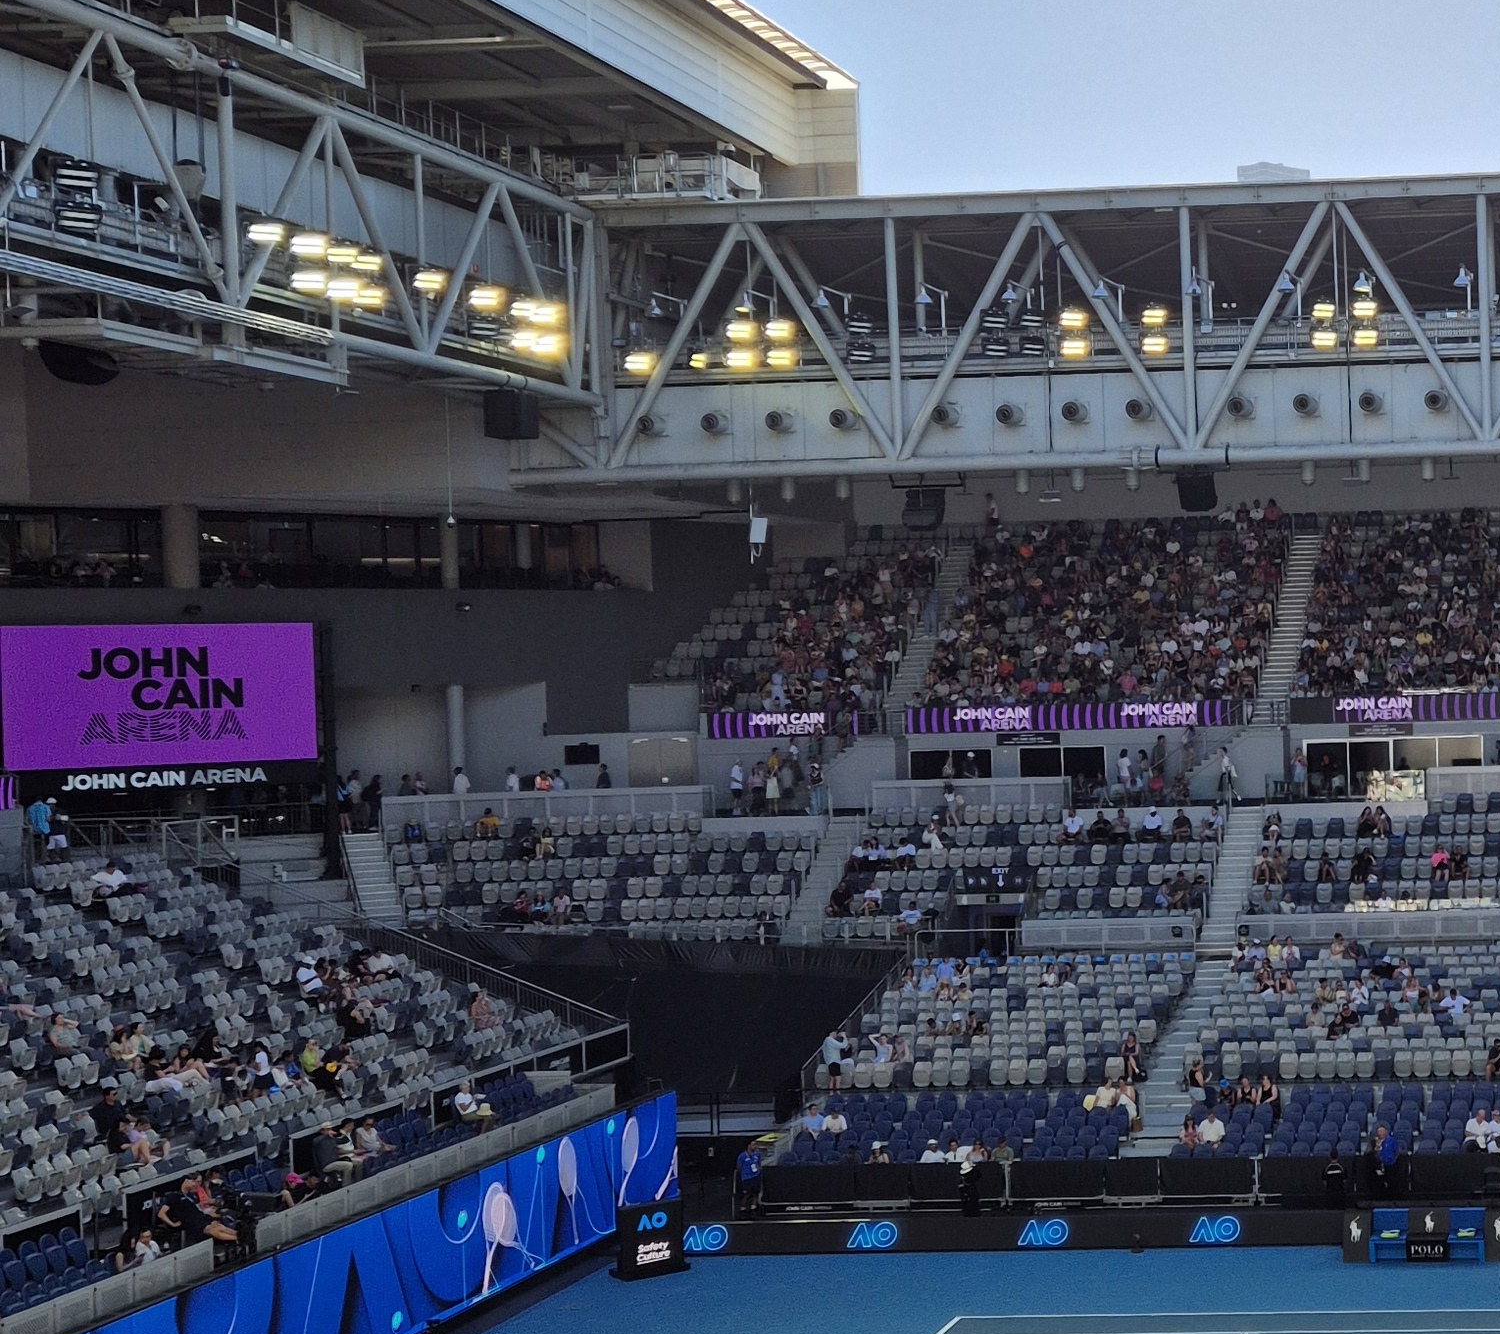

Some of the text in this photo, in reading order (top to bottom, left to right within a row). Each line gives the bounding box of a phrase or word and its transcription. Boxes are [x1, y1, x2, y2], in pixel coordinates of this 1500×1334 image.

[77, 646, 209, 680] JOHN
[131, 678, 244, 710] CAIN
[1120, 702, 1197, 716] JOHN CAIN
[1335, 697, 1412, 711] JOHN CAIN
[748, 712, 825, 726] JOHN CAIN
[953, 707, 1029, 721] JOHN CAIN
[1363, 708, 1413, 720] ARENA
[80, 709, 249, 746] ARENA
[980, 718, 1030, 730] ARENA
[61, 767, 268, 791] JOHN CAIN ARENA
[637, 1212, 667, 1231] AO
[1189, 1216, 1240, 1243] AO
[683, 1224, 729, 1251] AO
[847, 1221, 898, 1248] AO
[1017, 1219, 1069, 1246] AO
[637, 1241, 670, 1253] Safety
[1411, 1244, 1444, 1255] POLO
[636, 1250, 671, 1263] Culture
